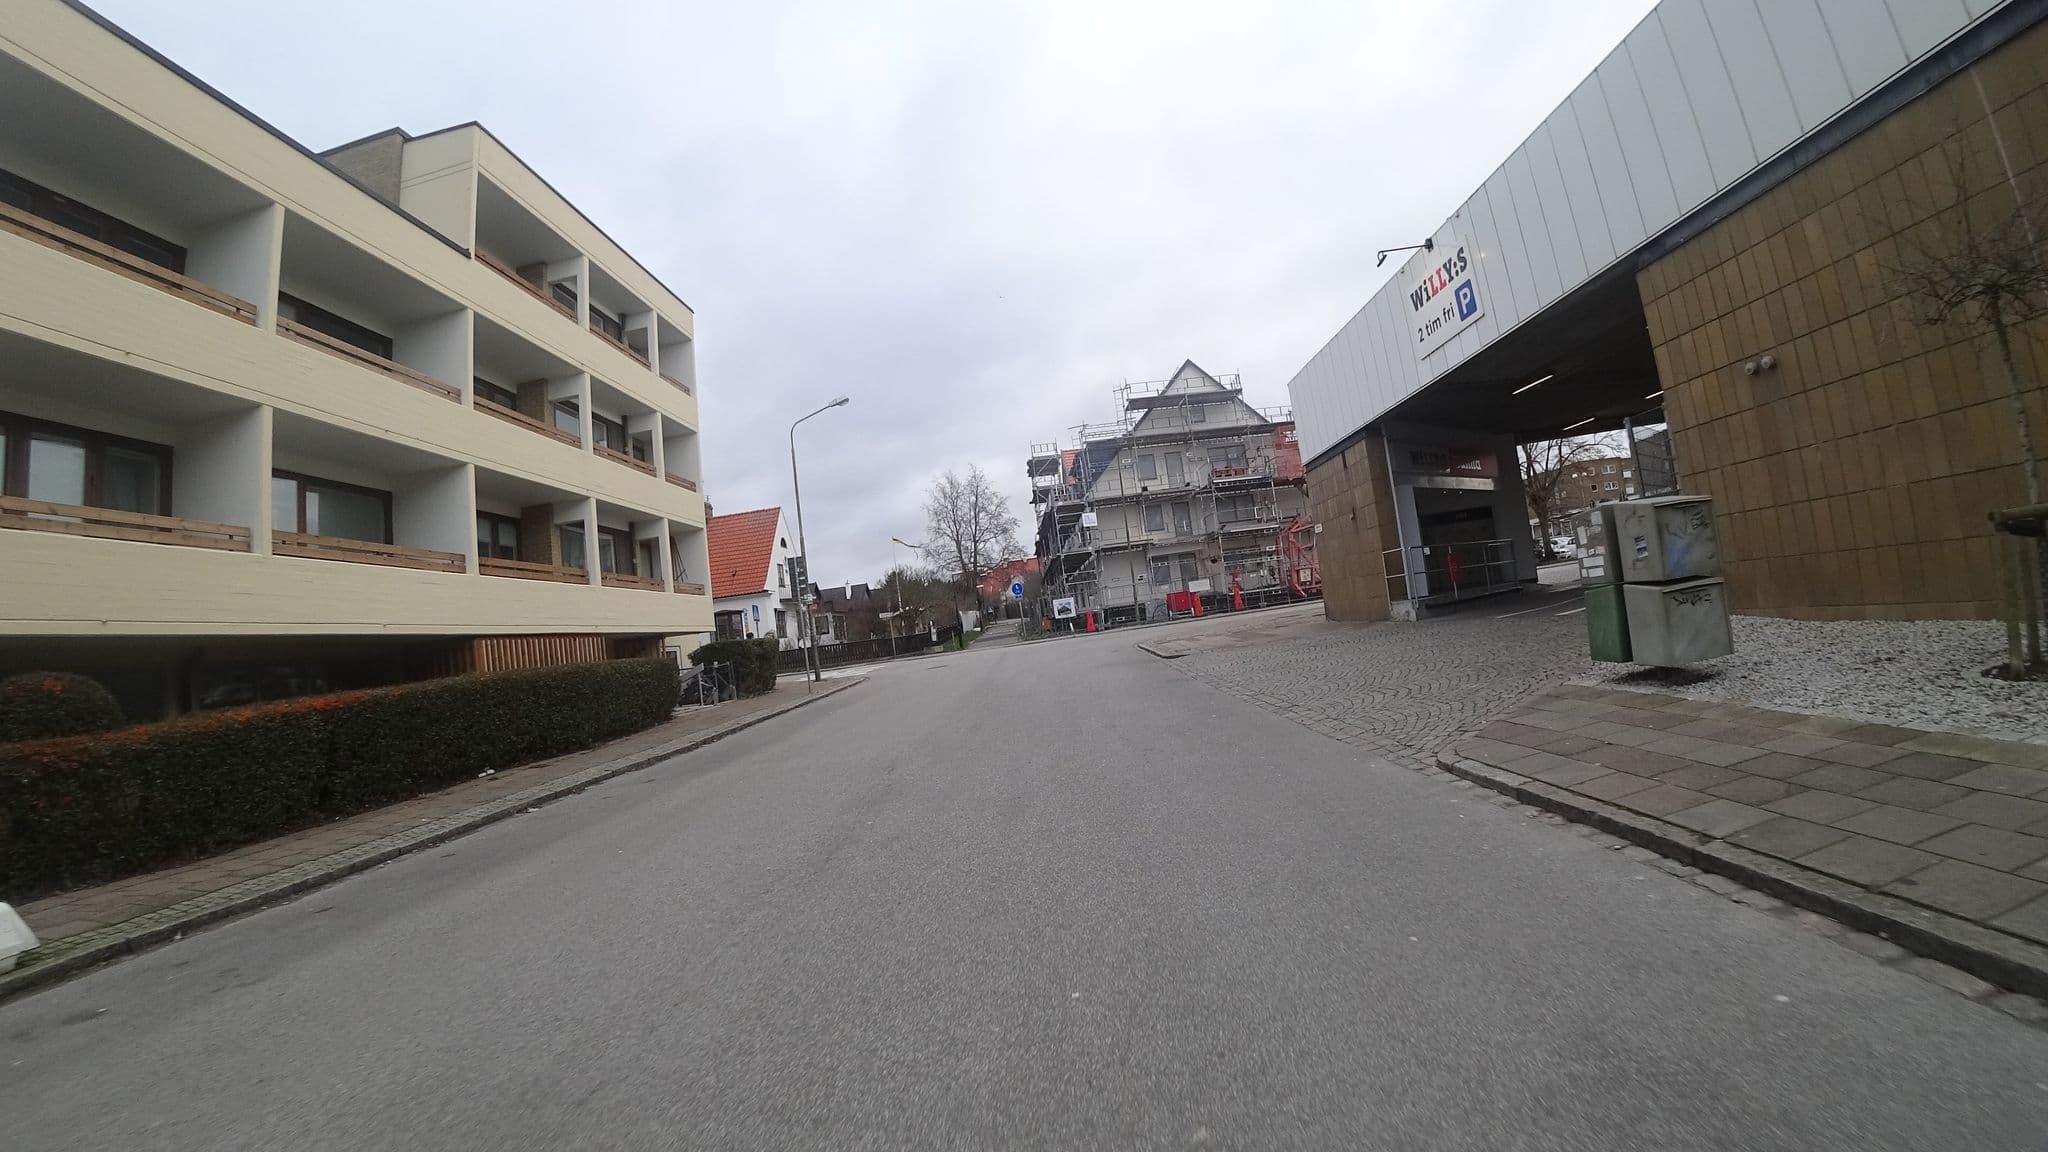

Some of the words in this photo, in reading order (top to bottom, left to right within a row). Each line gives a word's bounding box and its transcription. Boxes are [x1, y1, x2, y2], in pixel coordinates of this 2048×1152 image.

[1418, 327, 1425, 343] 2
[1425, 317, 1442, 337] tim
[1443, 302, 1455, 323] fri
[1459, 287, 1471, 314] P
